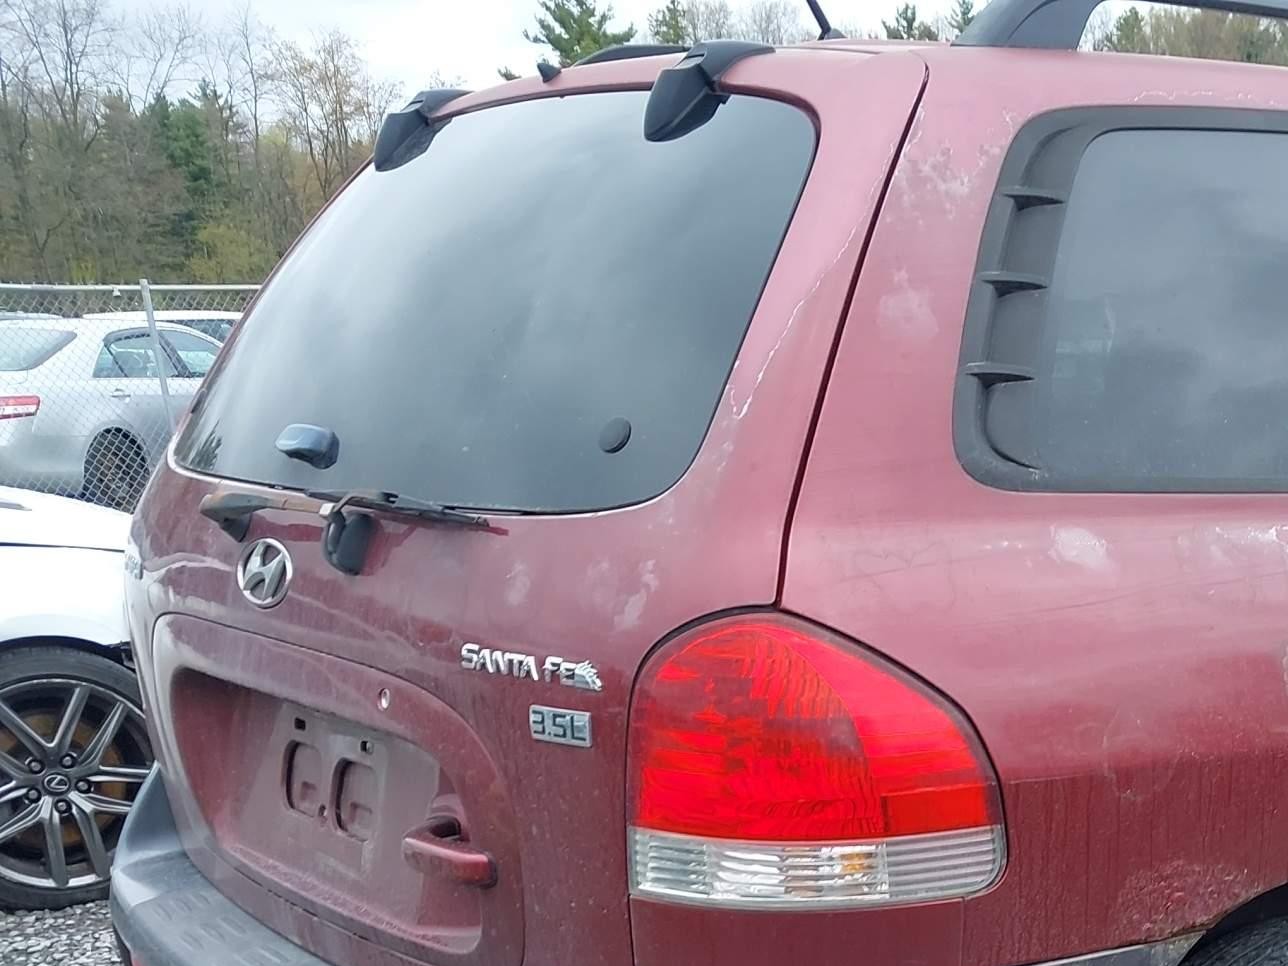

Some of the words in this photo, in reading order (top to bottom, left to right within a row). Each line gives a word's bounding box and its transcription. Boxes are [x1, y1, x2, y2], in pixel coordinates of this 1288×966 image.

[461, 643, 538, 681] SANTA
[542, 656, 602, 691] FE
[532, 710, 587, 741] 3.5L
